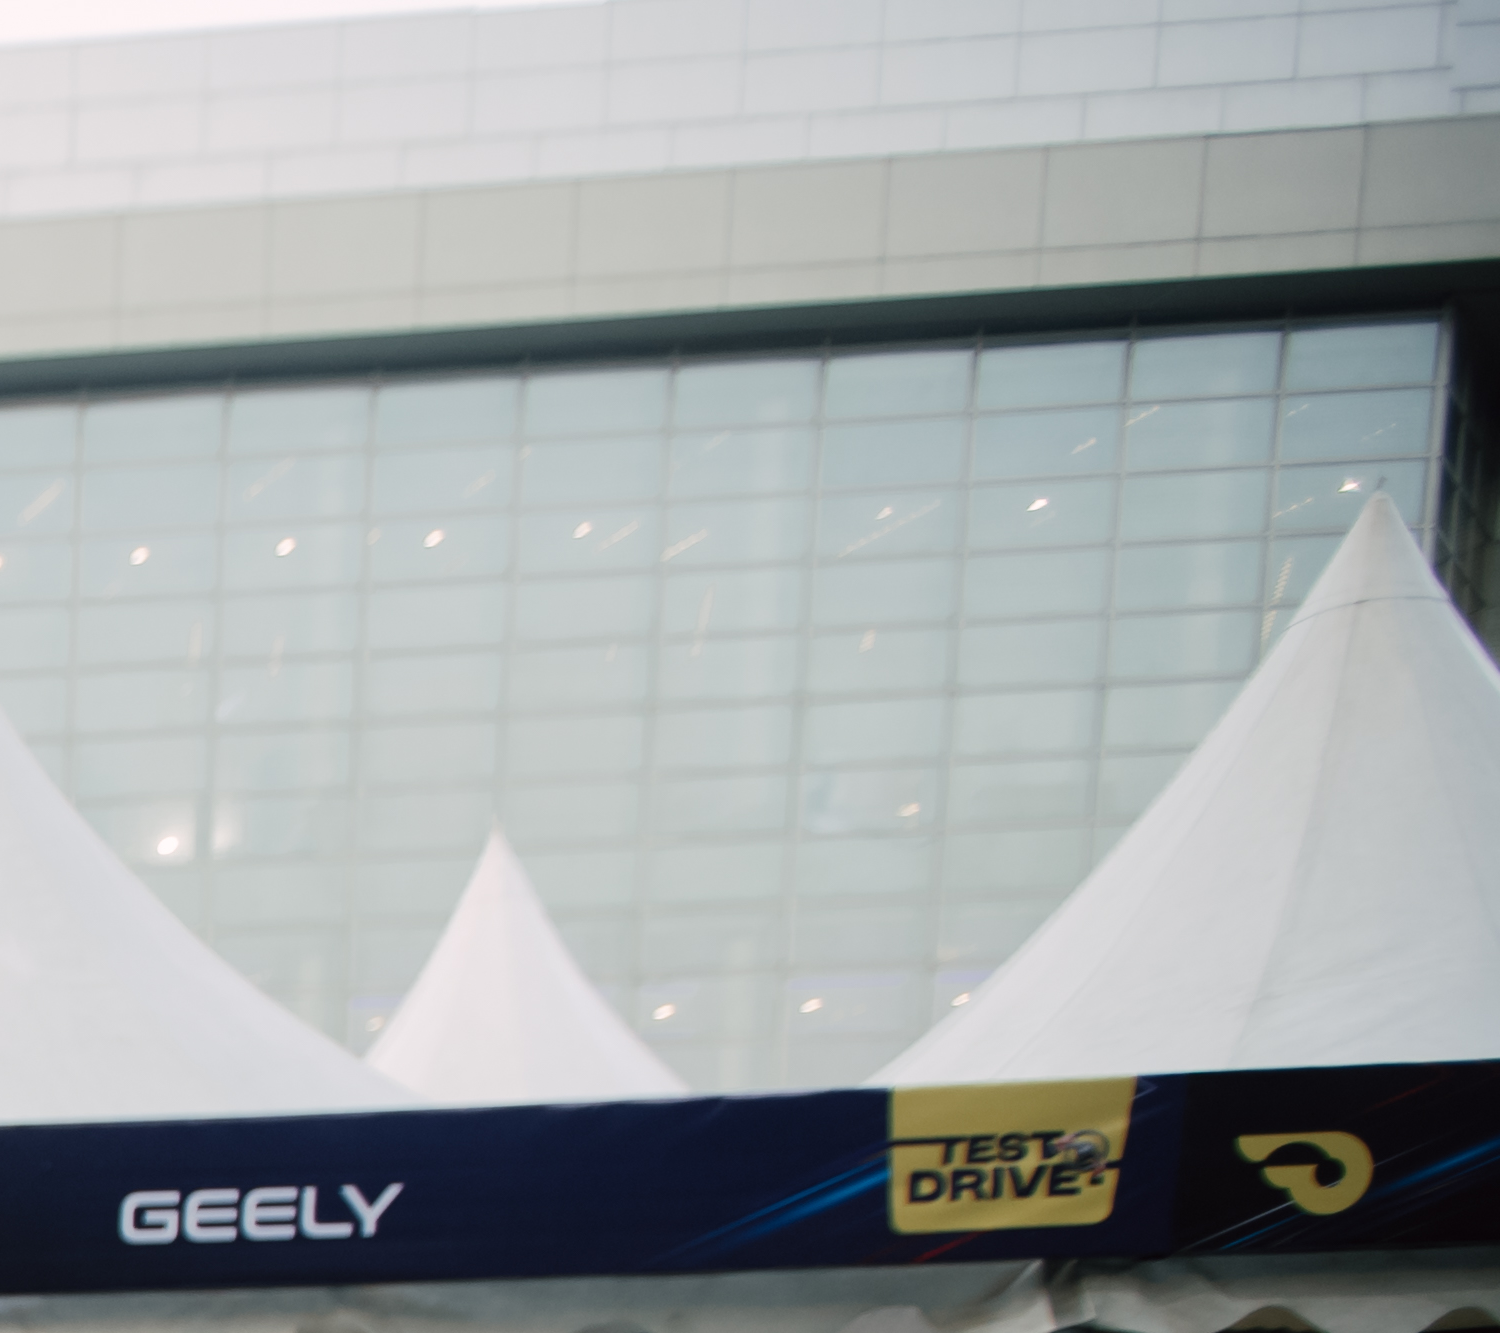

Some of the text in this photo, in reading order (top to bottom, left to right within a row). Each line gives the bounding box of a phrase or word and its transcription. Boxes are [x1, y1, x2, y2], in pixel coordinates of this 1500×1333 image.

[937, 1130, 1065, 1166] TEST
[908, 1164, 1082, 1204] DRIVE
[118, 1182, 404, 1245] GEELY
